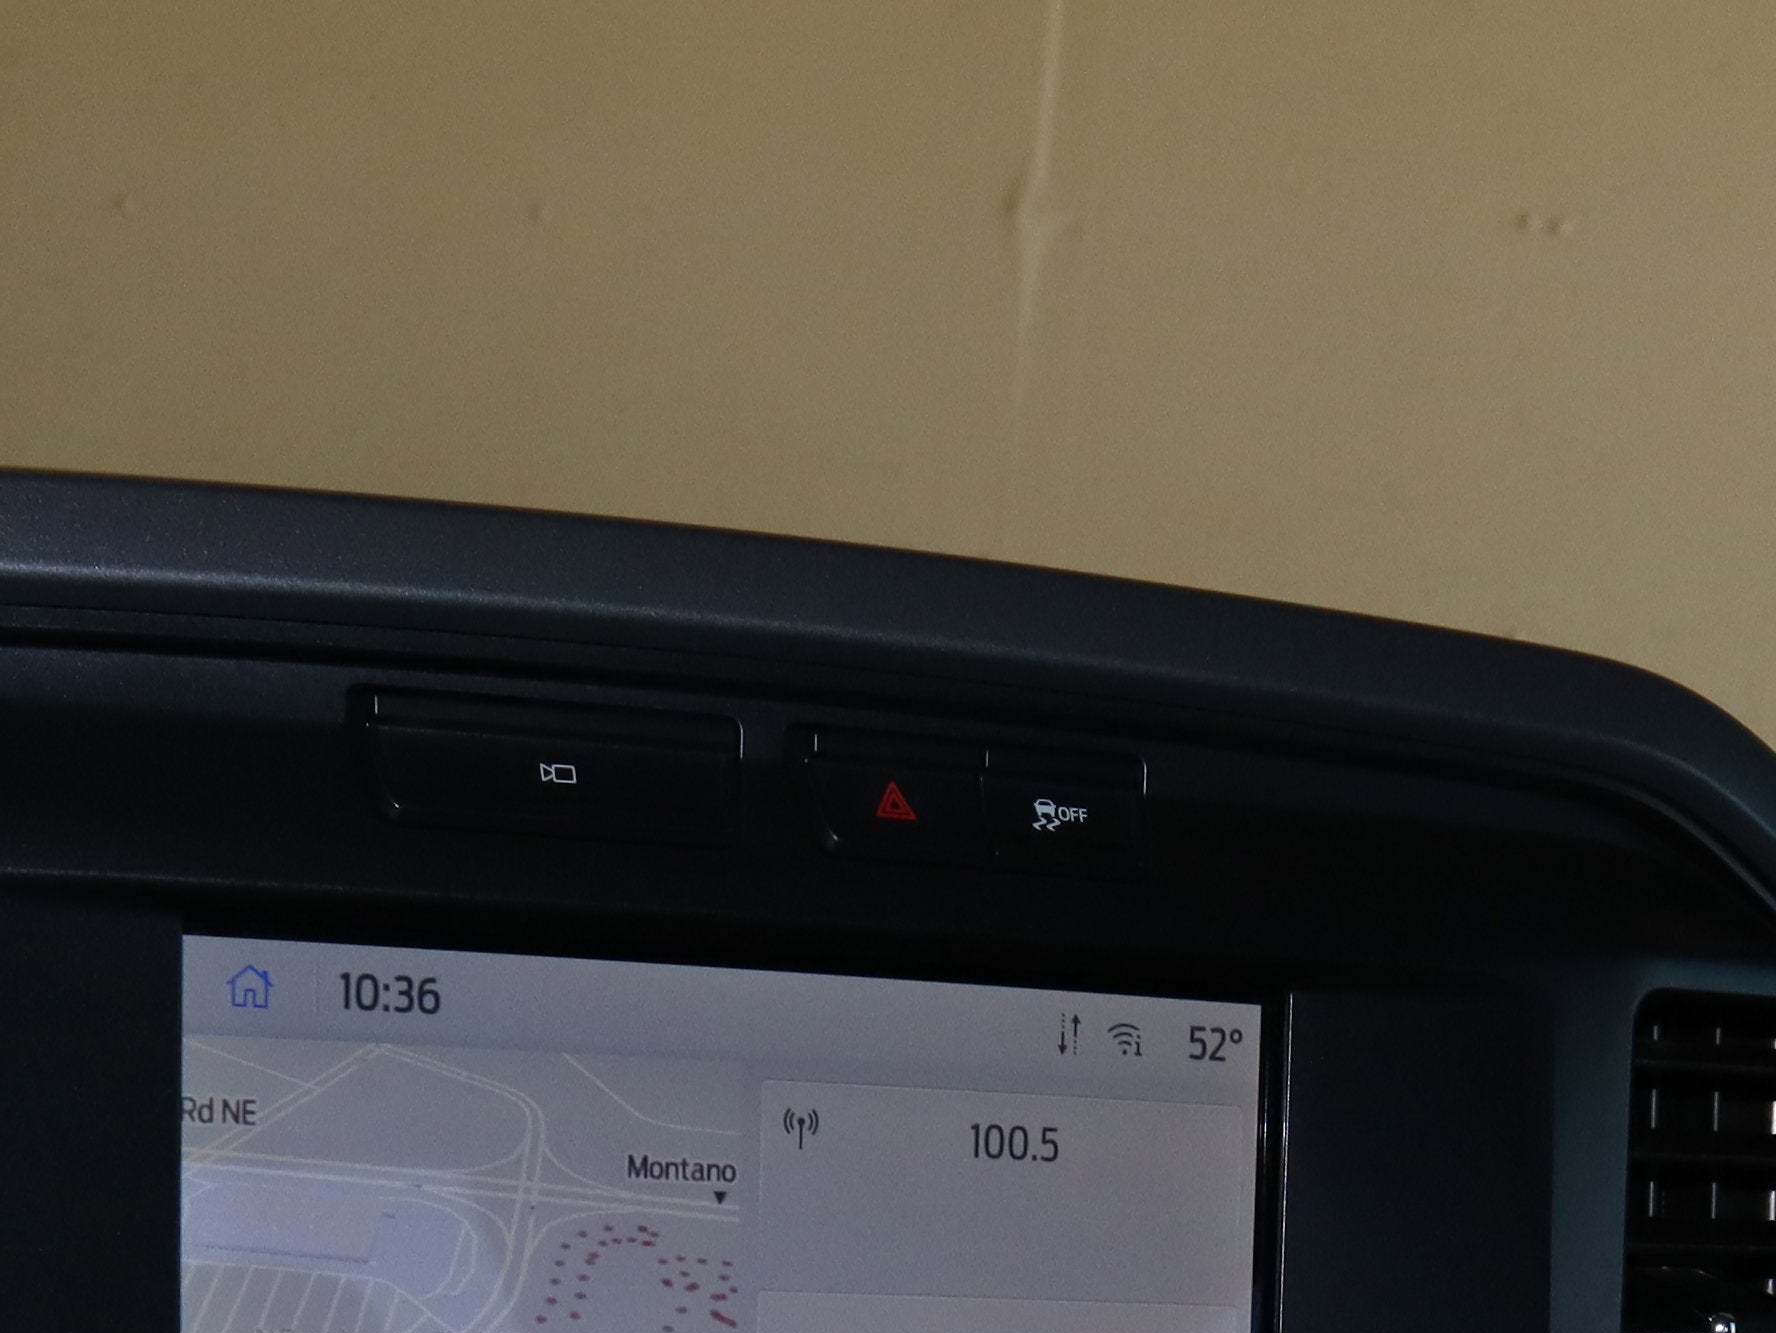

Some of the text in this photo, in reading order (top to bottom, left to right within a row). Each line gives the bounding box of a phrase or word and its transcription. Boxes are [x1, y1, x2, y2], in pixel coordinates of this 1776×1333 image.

[1058, 805, 1088, 825] OFF
[340, 971, 441, 1015] 10:36
[181, 1096, 256, 1126] Rd NE
[970, 1123, 1060, 1162] 100.5
[627, 1154, 737, 1184] Montano
